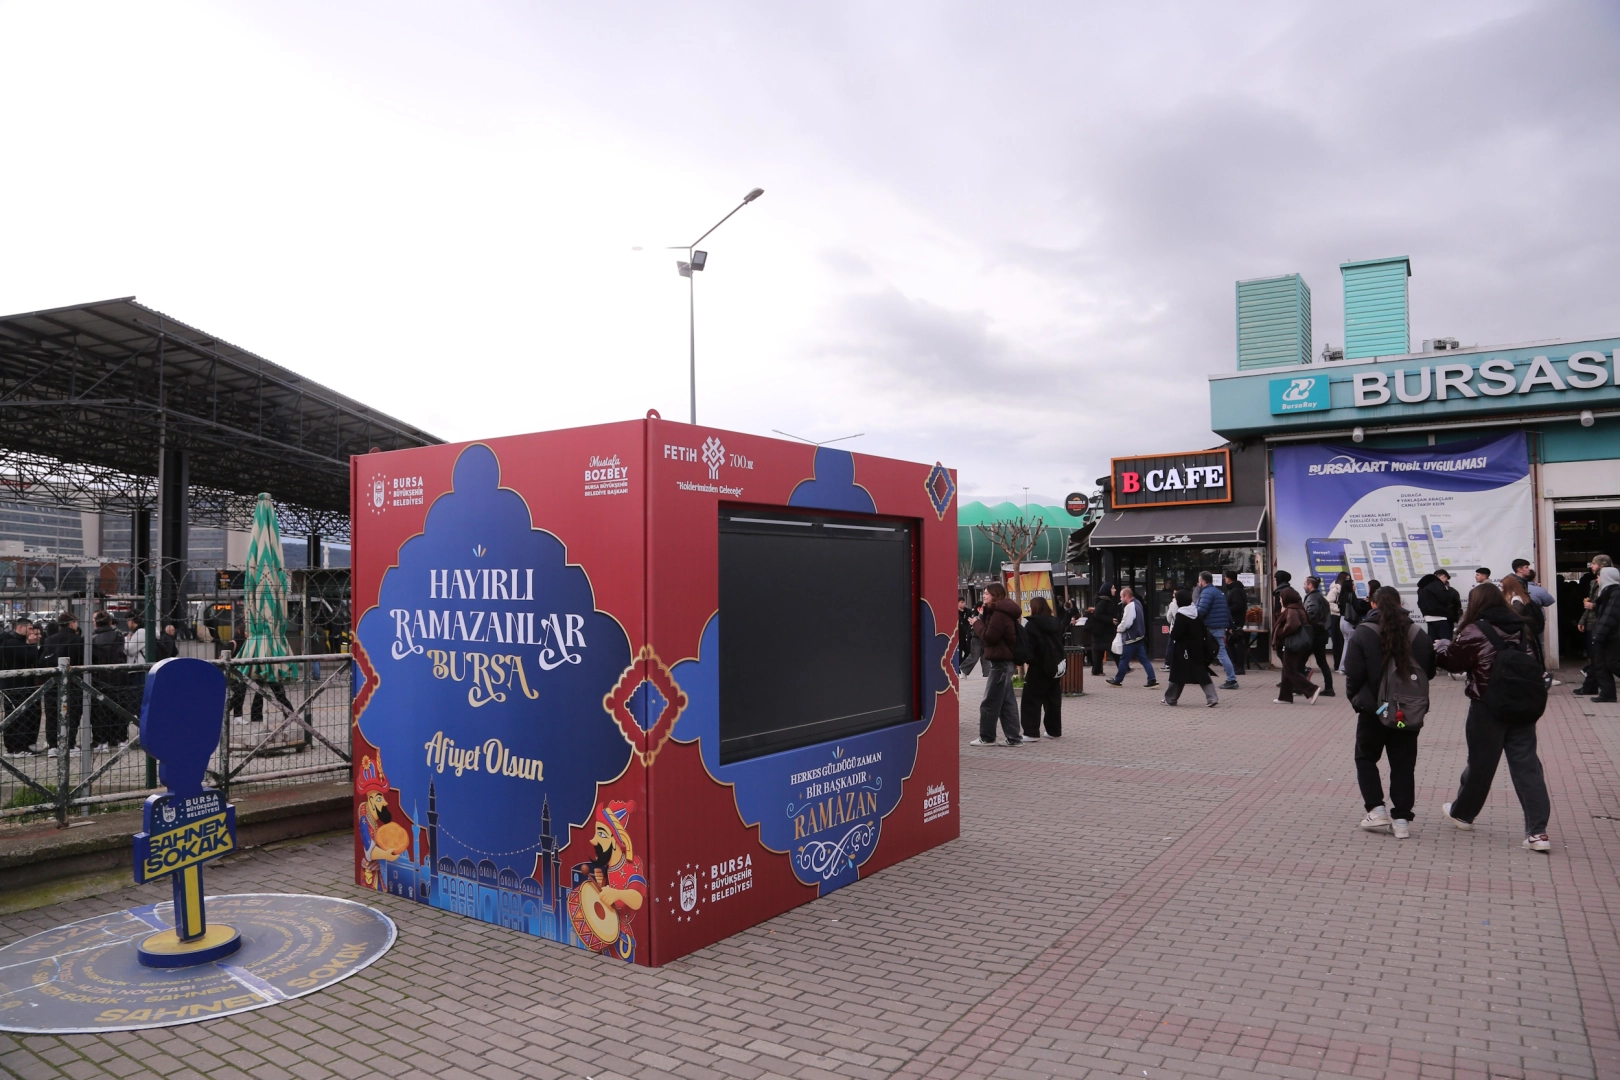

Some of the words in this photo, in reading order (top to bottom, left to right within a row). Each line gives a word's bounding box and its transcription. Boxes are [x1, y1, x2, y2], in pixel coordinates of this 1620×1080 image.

[1352, 347, 1620, 408] BURSAS
[1281, 401, 1318, 410] BursaRay
[584, 466, 628, 482] BOZBEY
[589, 453, 621, 469] Mustafa
[1308, 459, 1389, 476] BURSAKART
[1391, 460, 1421, 471] MOBİL
[1423, 456, 1488, 472] UYGULAMASI
[393, 475, 424, 489] BURSA
[393, 487, 424, 498] BÜYÜKŞEHİR
[584, 489, 607, 497] BELEDİYE
[607, 488, 629, 496] BAŞKANI
[1121, 471, 1141, 494] B
[1146, 465, 1224, 492] CAFE
[393, 496, 424, 507] BELEDİYESİ
[429, 568, 535, 601] HAYIRLI
[389, 608, 587, 671] RAMAZANLAR
[426, 649, 540, 708] BURSA
[424, 730, 481, 777] Afiyet
[482, 738, 544, 782] Olsun
[790, 767, 822, 786] HERKES
[822, 756, 857, 777] GÜLDÜĞÜ
[857, 751, 882, 768] ZAMAN
[806, 782, 822, 799] BİR
[823, 771, 867, 794] BAŞKADIR
[185, 793, 219, 807] BURSA
[186, 804, 220, 818] BELEDİYESİ
[923, 791, 950, 810] BOZBEY
[793, 791, 878, 841] RAMAZAN
[149, 818, 227, 855] SAHNEM
[146, 829, 229, 874] SOKAK
[710, 853, 753, 879] BURSA
[711, 867, 753, 891] BÜYÜKŞEHİR
[711, 877, 753, 903] BELEDİYESİ
[286, 941, 369, 989] SOKAK
